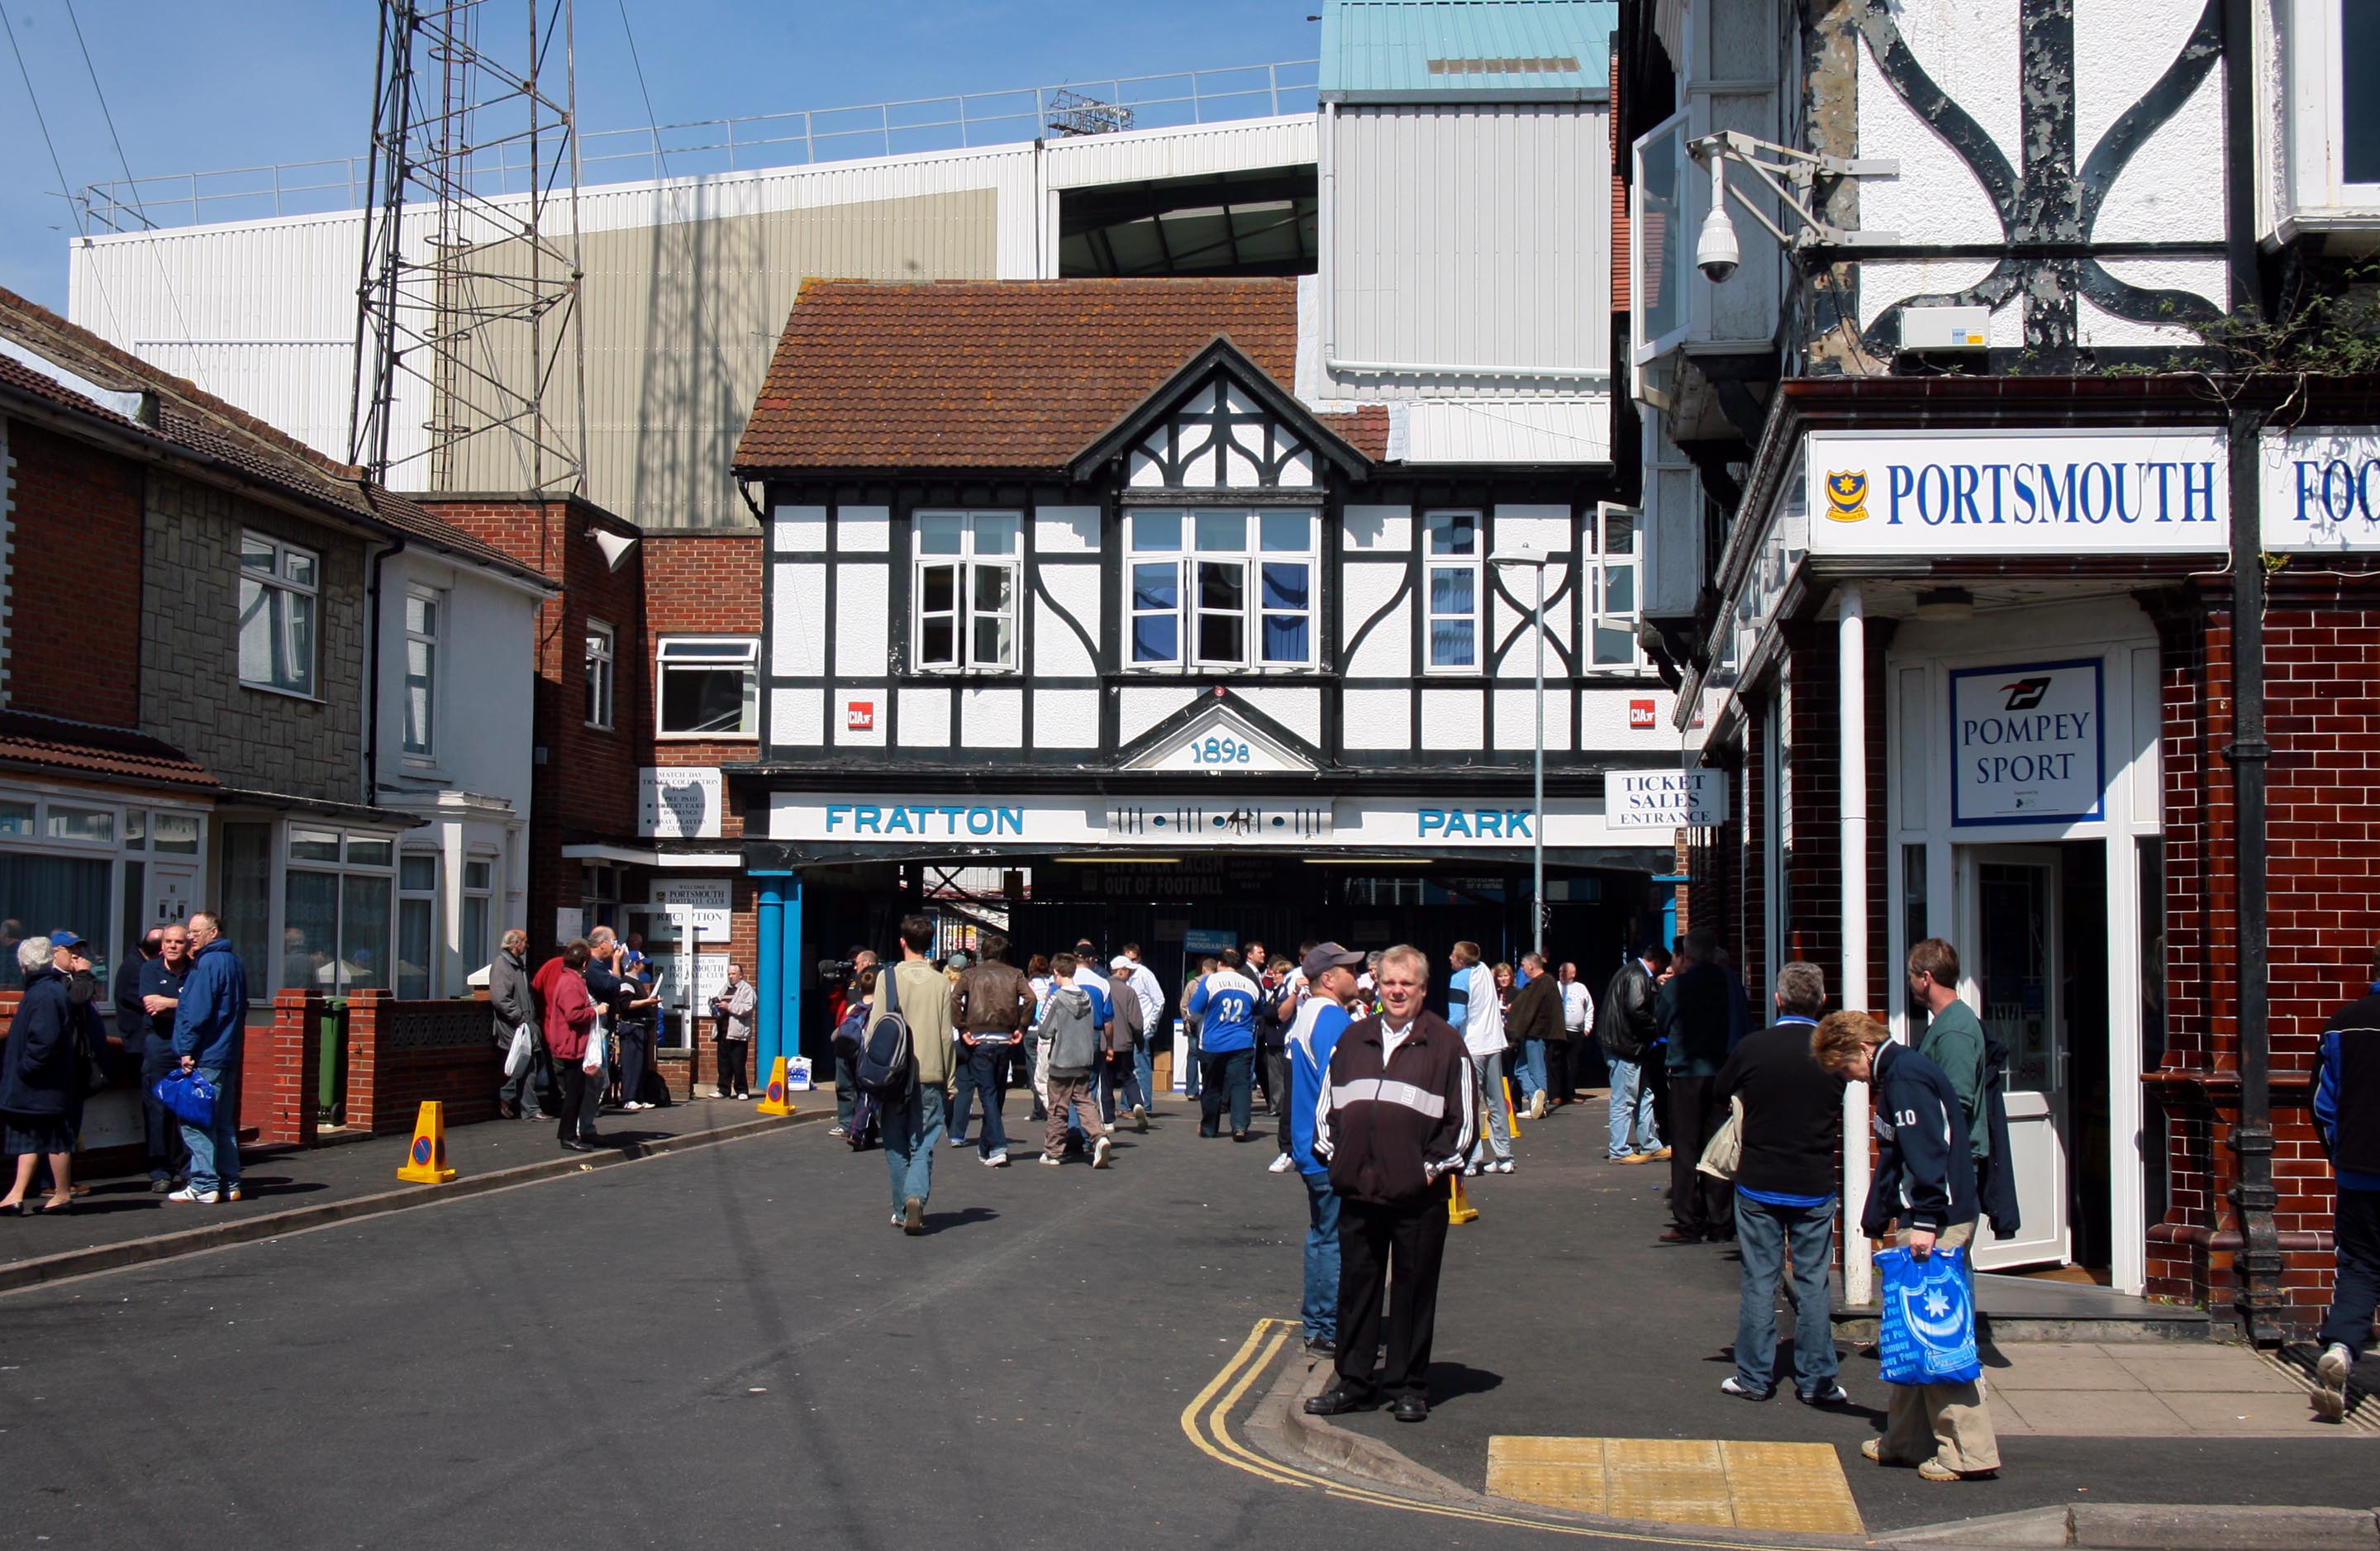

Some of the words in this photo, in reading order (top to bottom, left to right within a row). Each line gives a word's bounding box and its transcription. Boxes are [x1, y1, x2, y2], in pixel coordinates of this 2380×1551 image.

[1885, 462, 2216, 526] PORTSMOUTH
[1963, 711, 2091, 746] POMPEY
[1191, 736, 1250, 764] 1898
[1977, 753, 2075, 783] SPORT
[1621, 775, 1706, 792] TICKET
[1630, 792, 1700, 809] SALES
[826, 805, 1024, 835] FRATTON
[1418, 809, 1533, 838] PARK
[1621, 811, 1711, 825] ENTRANCE
[669, 890, 725, 898] PORTSMOUTH
[1104, 876, 1131, 895] OUT
[1135, 876, 1152, 895] OF
[1156, 876, 1224, 895] FOOTBALL
[1219, 997, 1243, 1023] 32
[1895, 1109, 1916, 1127] 10
